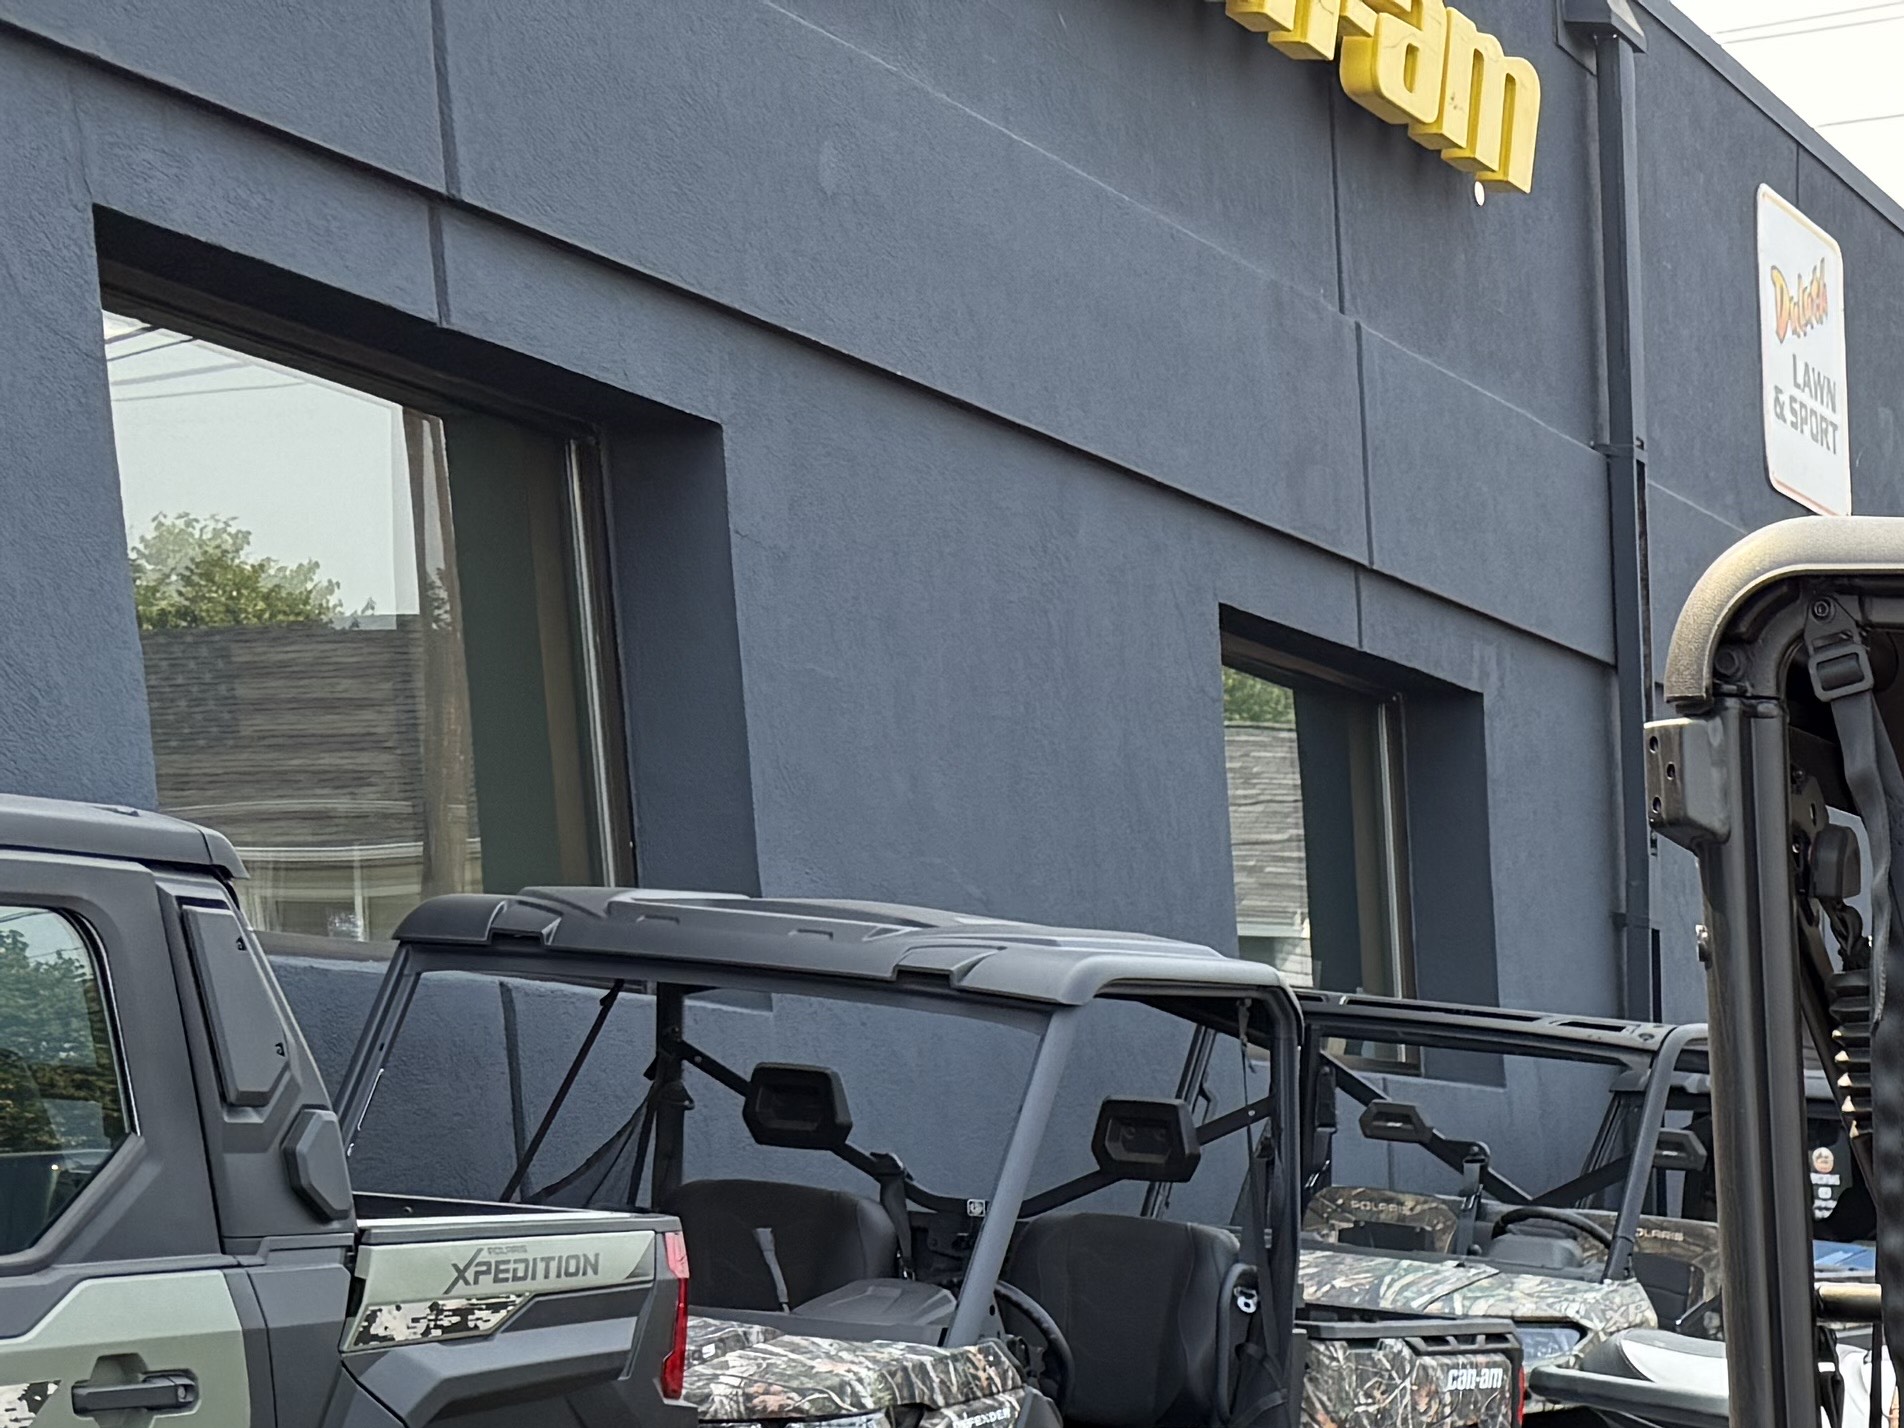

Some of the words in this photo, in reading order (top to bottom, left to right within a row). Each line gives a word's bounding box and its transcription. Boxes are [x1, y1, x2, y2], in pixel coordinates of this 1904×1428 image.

[1792, 353, 1837, 415] LAWN
[1773, 384, 1787, 425] &
[1789, 394, 1839, 455] SPORT
[443, 1248, 601, 1295] XPEDITION
[486, 1244, 528, 1255] POLARIS
[1446, 1367, 1504, 1391] can-am
